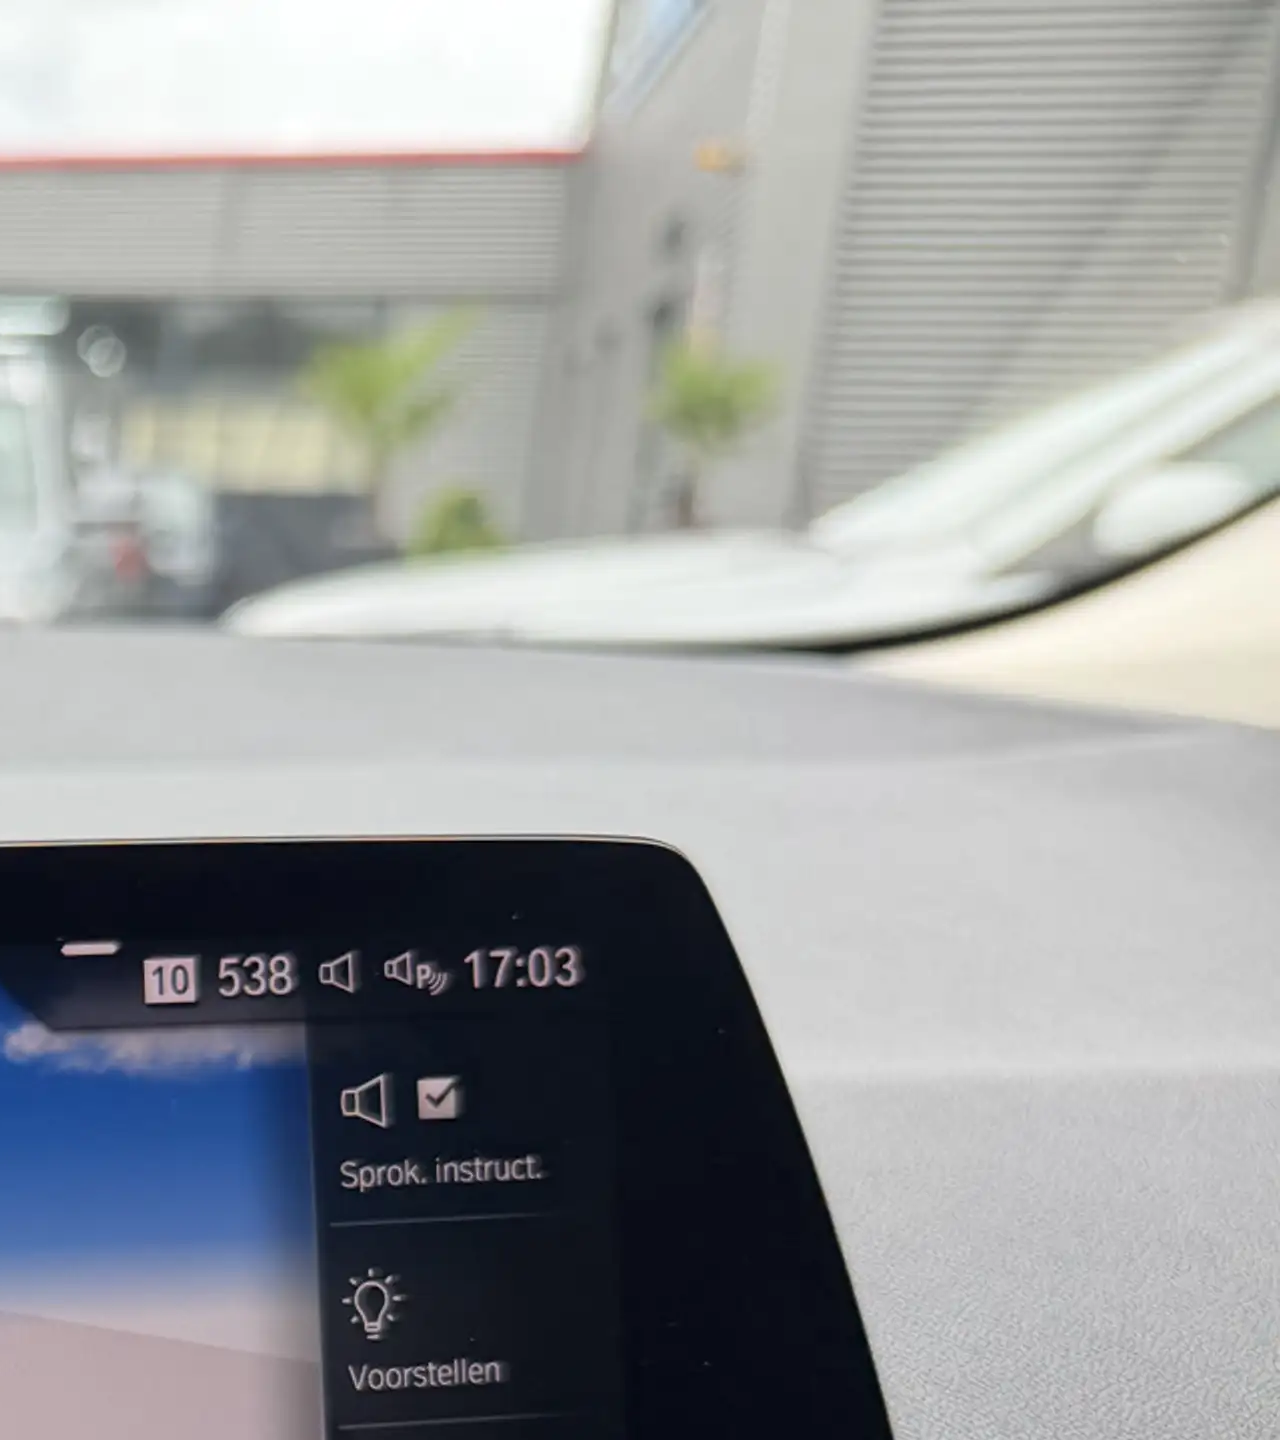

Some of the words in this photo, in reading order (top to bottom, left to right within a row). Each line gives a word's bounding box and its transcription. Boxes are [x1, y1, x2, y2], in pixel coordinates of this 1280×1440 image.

[150, 965, 190, 995] 10
[218, 955, 294, 997] 538
[463, 947, 583, 989] 17:03
[341, 1161, 427, 1192] Sprok.
[436, 1155, 543, 1184] instruct.
[349, 1359, 502, 1392] Voorstellen
